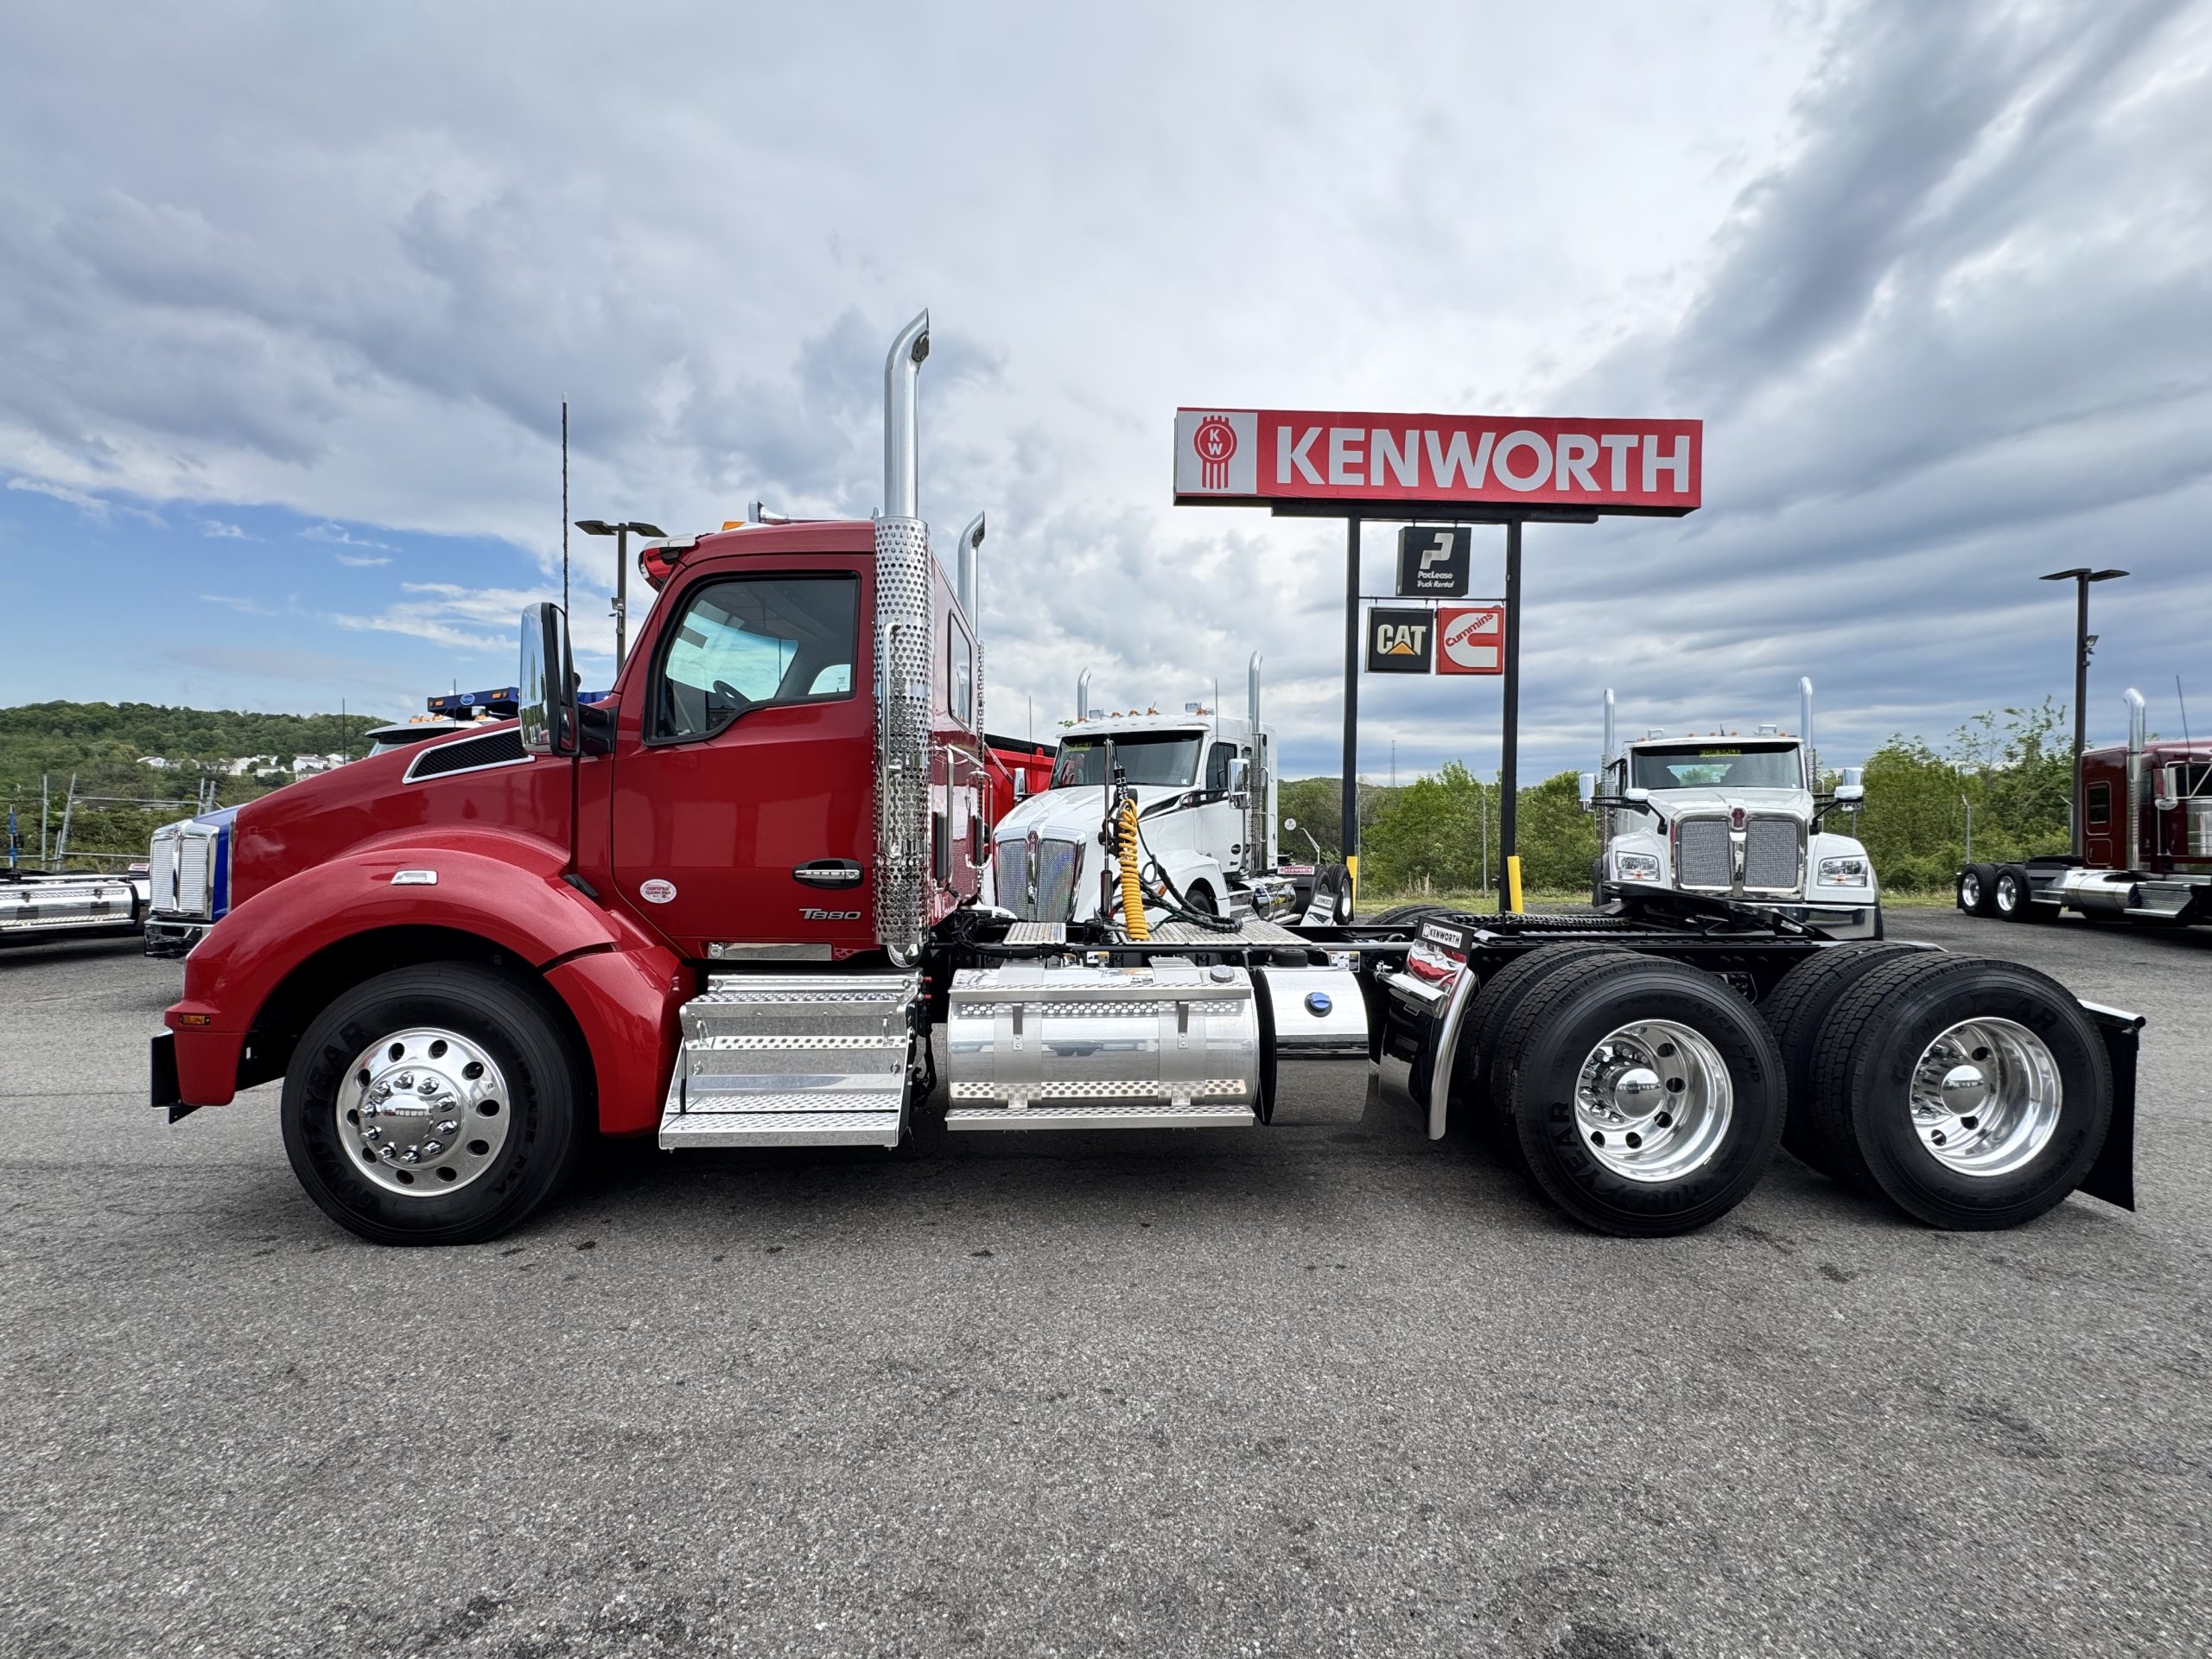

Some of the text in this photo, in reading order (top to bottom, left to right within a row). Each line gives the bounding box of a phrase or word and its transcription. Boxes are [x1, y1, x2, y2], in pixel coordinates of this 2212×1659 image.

[1210, 429, 1220, 442] K
[1207, 442, 1223, 455] W
[1276, 426, 1690, 492] KENWORTH
[1417, 570, 1453, 579] PacLease
[1433, 580, 1455, 588] Rental
[1446, 613, 1494, 646] Cummins
[1376, 624, 1427, 656] CAT
[798, 908, 861, 920] T880
[1429, 928, 1460, 945] KENWORTH
